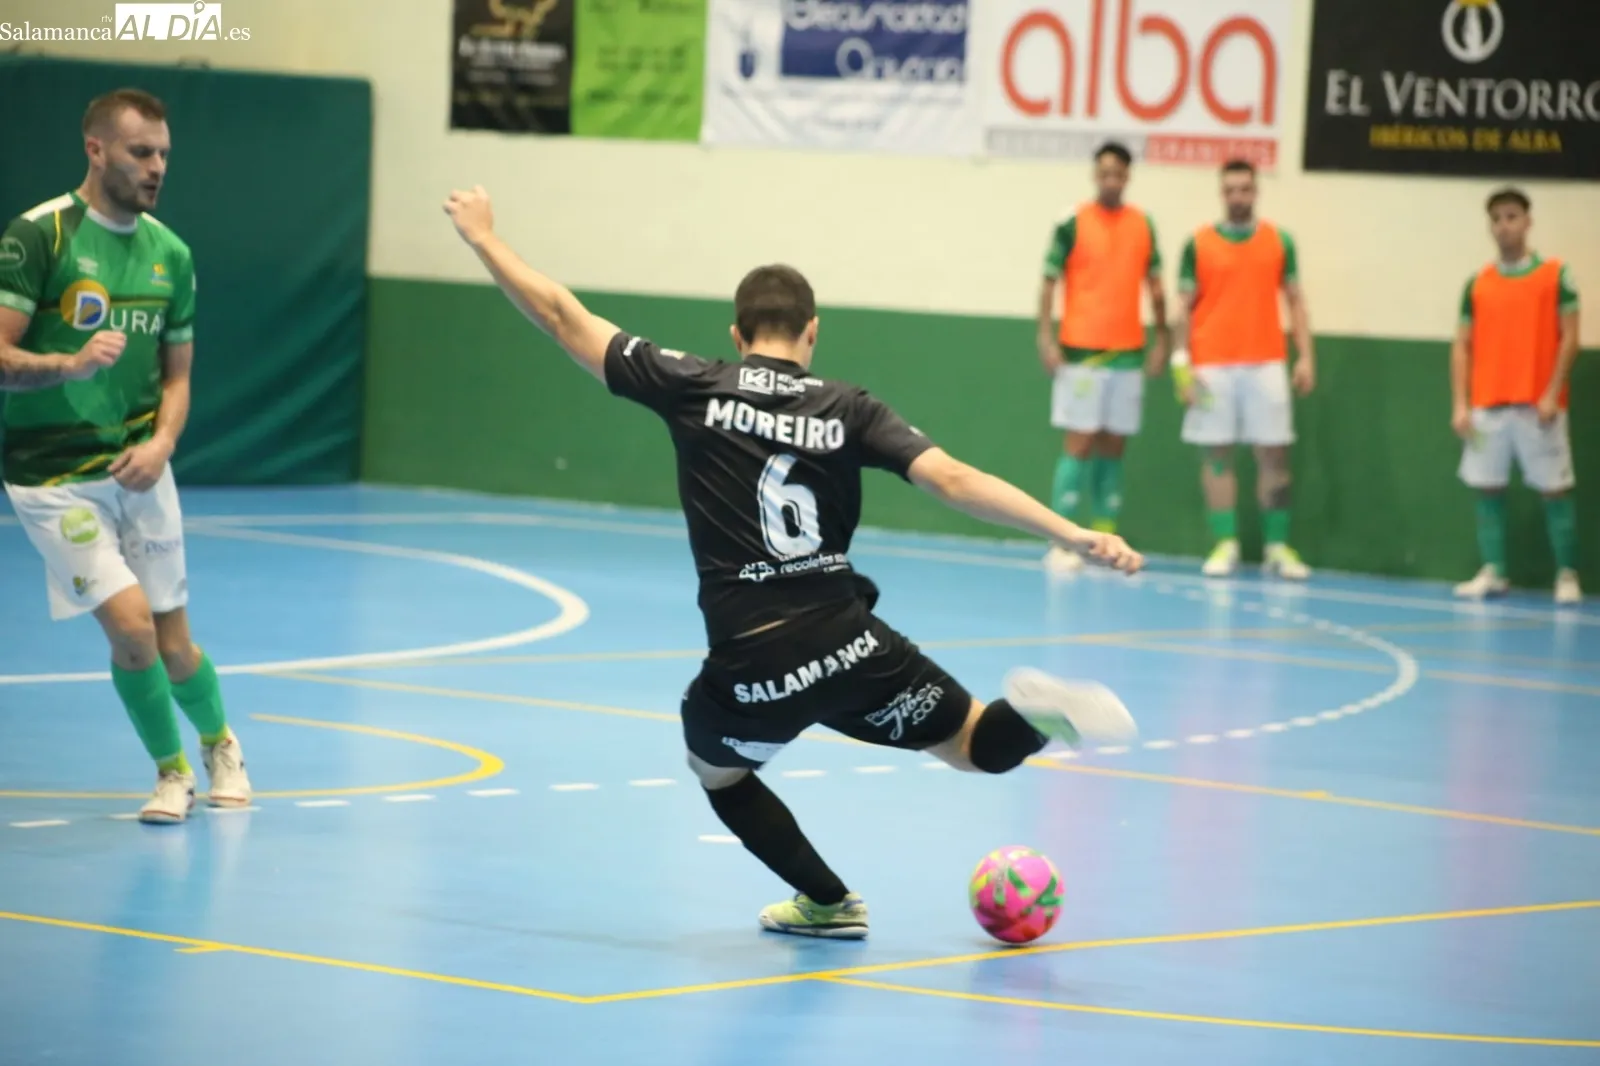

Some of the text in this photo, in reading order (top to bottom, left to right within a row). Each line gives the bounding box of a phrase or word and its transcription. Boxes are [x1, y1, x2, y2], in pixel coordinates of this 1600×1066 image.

[1000, 0, 1278, 125] alba
[1324, 69, 1370, 116] EL
[704, 398, 846, 450] MOREIRO
[756, 453, 823, 559] 6
[733, 630, 881, 703] SALAMANCA
